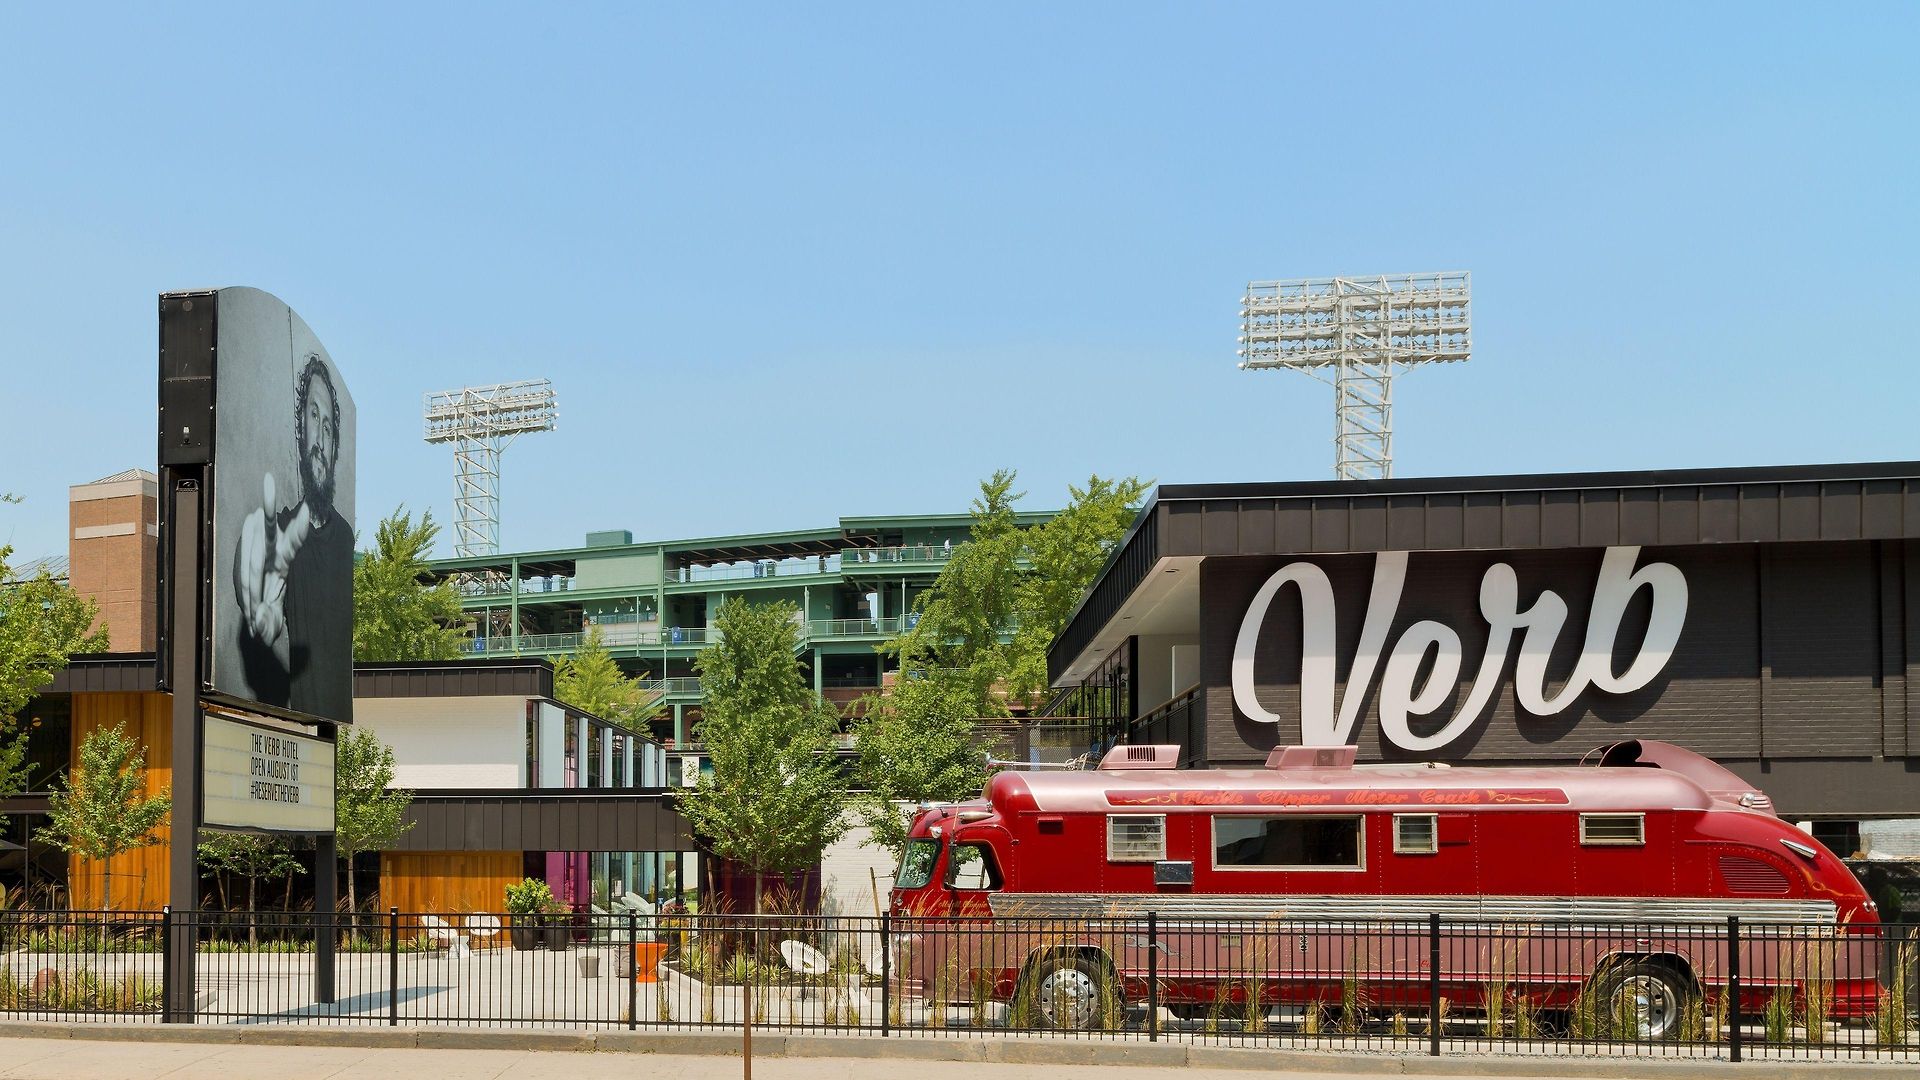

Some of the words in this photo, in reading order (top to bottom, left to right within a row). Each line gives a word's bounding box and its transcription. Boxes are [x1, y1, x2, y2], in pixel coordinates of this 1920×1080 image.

[1232, 546, 1689, 751] Verb
[251, 733, 262, 753] THE
[264, 736, 280, 756] VERB
[282, 739, 299, 760] HOTEL
[251, 756, 266, 777] OPEN
[267, 760, 290, 780] AUGUST
[251, 780, 300, 804] #RESERVETHEVERB
[1256, 790, 1331, 807] Clipper
[1344, 790, 1409, 804] Motor
[1418, 790, 1481, 804] Coach
